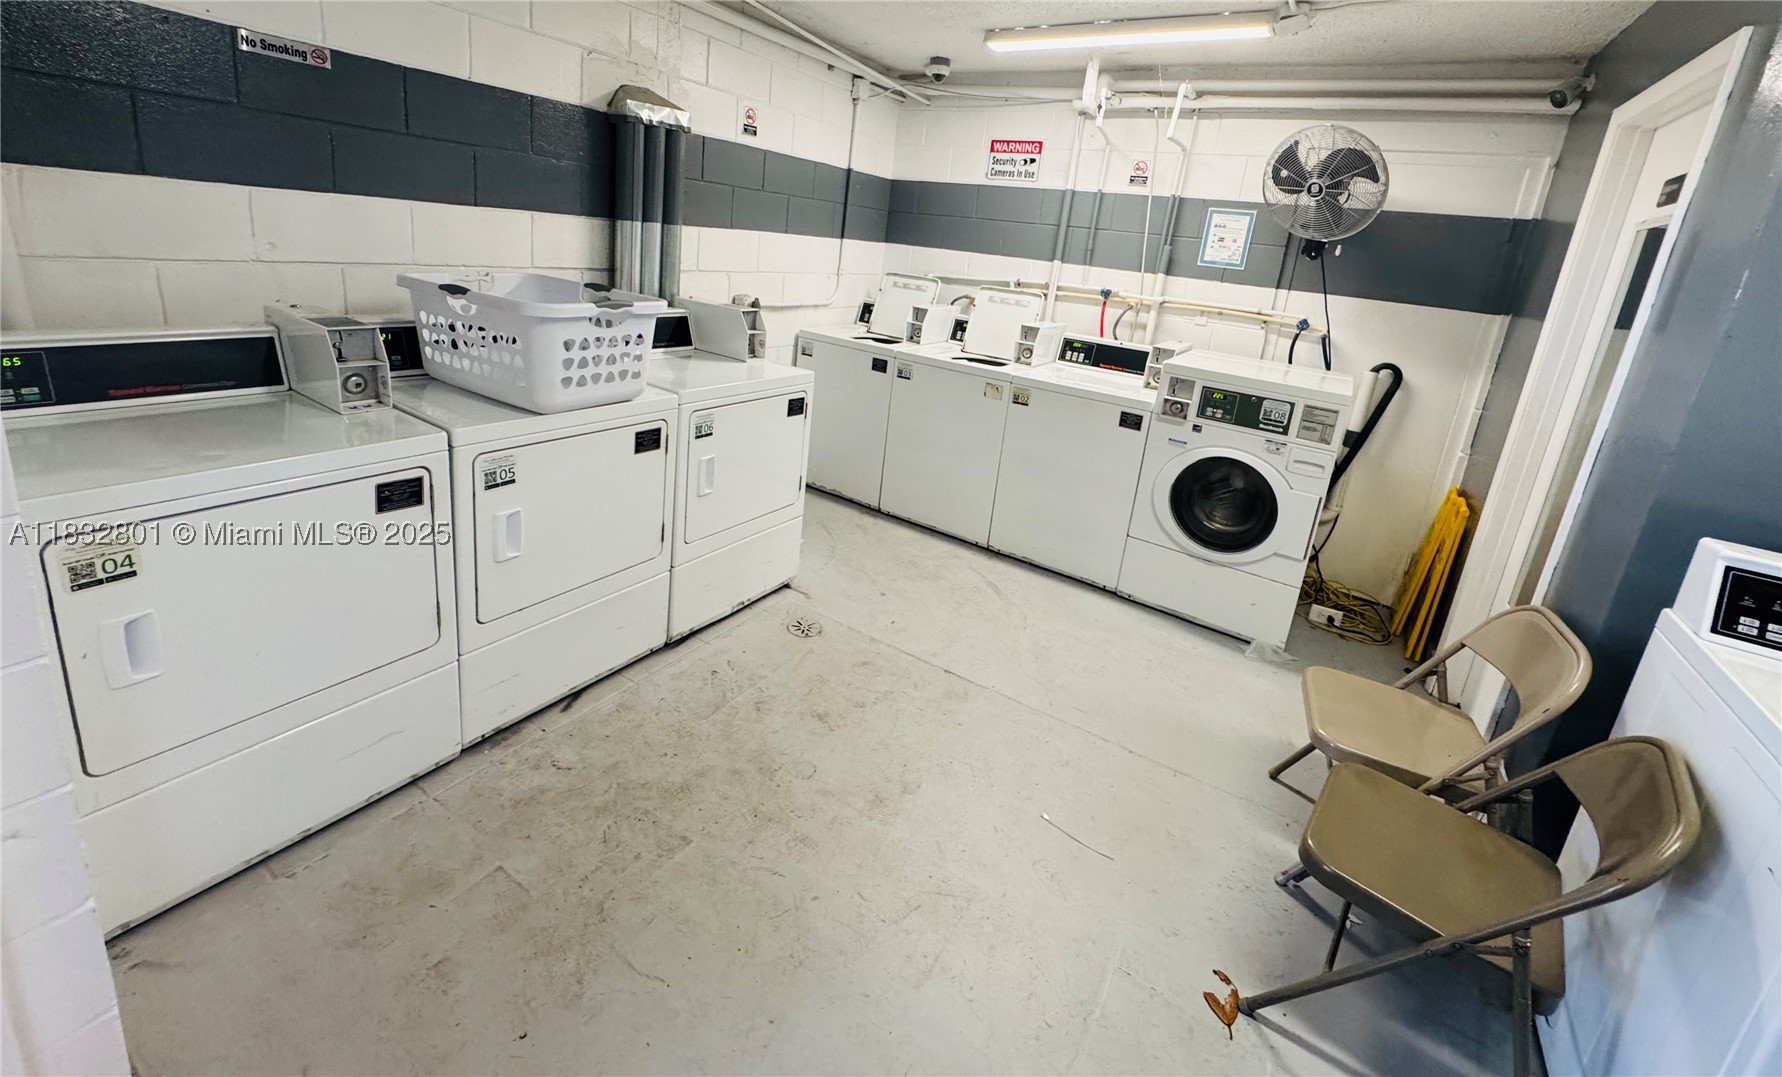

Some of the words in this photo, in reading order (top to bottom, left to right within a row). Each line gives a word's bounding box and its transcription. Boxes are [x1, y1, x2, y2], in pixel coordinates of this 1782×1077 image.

[240, 34, 257, 48] No
[259, 38, 308, 62] Smoking
[993, 141, 1040, 153] WARNING
[991, 155, 1017, 168] Security
[990, 167, 1015, 178] Cameras
[1017, 169, 1022, 178] In
[1024, 169, 1035, 179] Use
[903, 369, 912, 378] 03
[1020, 395, 1029, 403] 02
[1273, 411, 1287, 421] 08
[703, 422, 714, 433] 06
[499, 466, 516, 481] 05
[101, 554, 136, 575] 04
